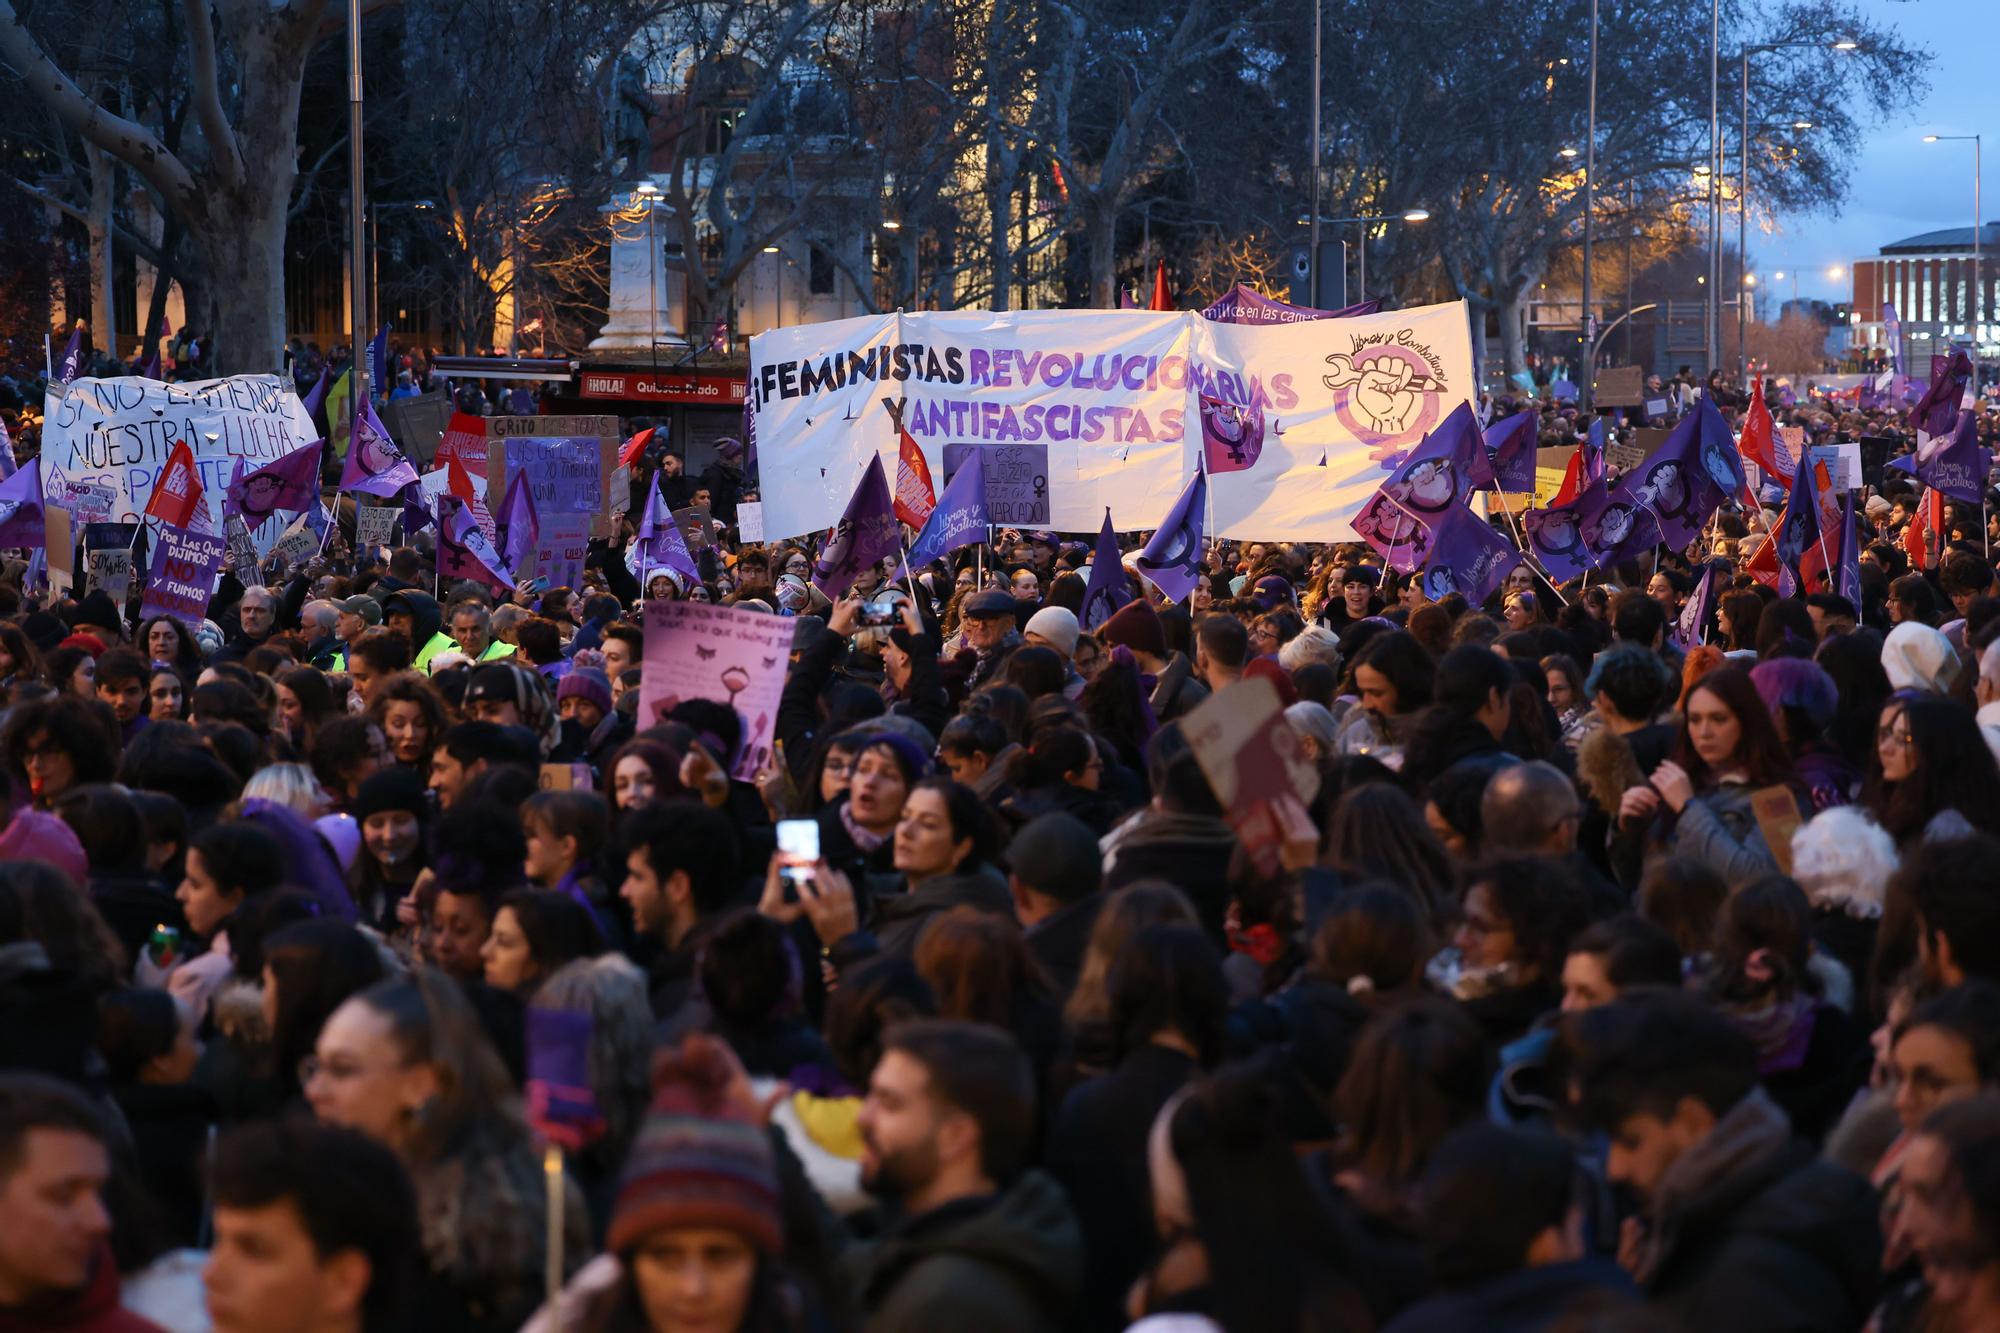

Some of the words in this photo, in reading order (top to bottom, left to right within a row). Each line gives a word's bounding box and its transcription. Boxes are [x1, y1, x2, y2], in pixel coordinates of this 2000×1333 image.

[1261, 304, 1277, 321] las
[588, 379, 625, 394] ¡HOLA!
[754, 344, 964, 413] ¡FEMINISTAS
[969, 348, 1299, 410] REVOLUCIONARIAS
[95, 383, 145, 415] NO
[881, 397, 907, 434] Y
[910, 398, 1184, 444] ANTIFASCISTAS
[68, 418, 199, 471] NUESTRA
[222, 415, 296, 458] LUCHA
[160, 528, 178, 544] POR
[183, 534, 201, 551] LAS
[203, 541, 222, 557] QUE
[168, 546, 210, 566] DIJIMOS
[163, 560, 196, 583] NO
[152, 577, 163, 588] Y
[167, 581, 206, 601] FUIMOS
